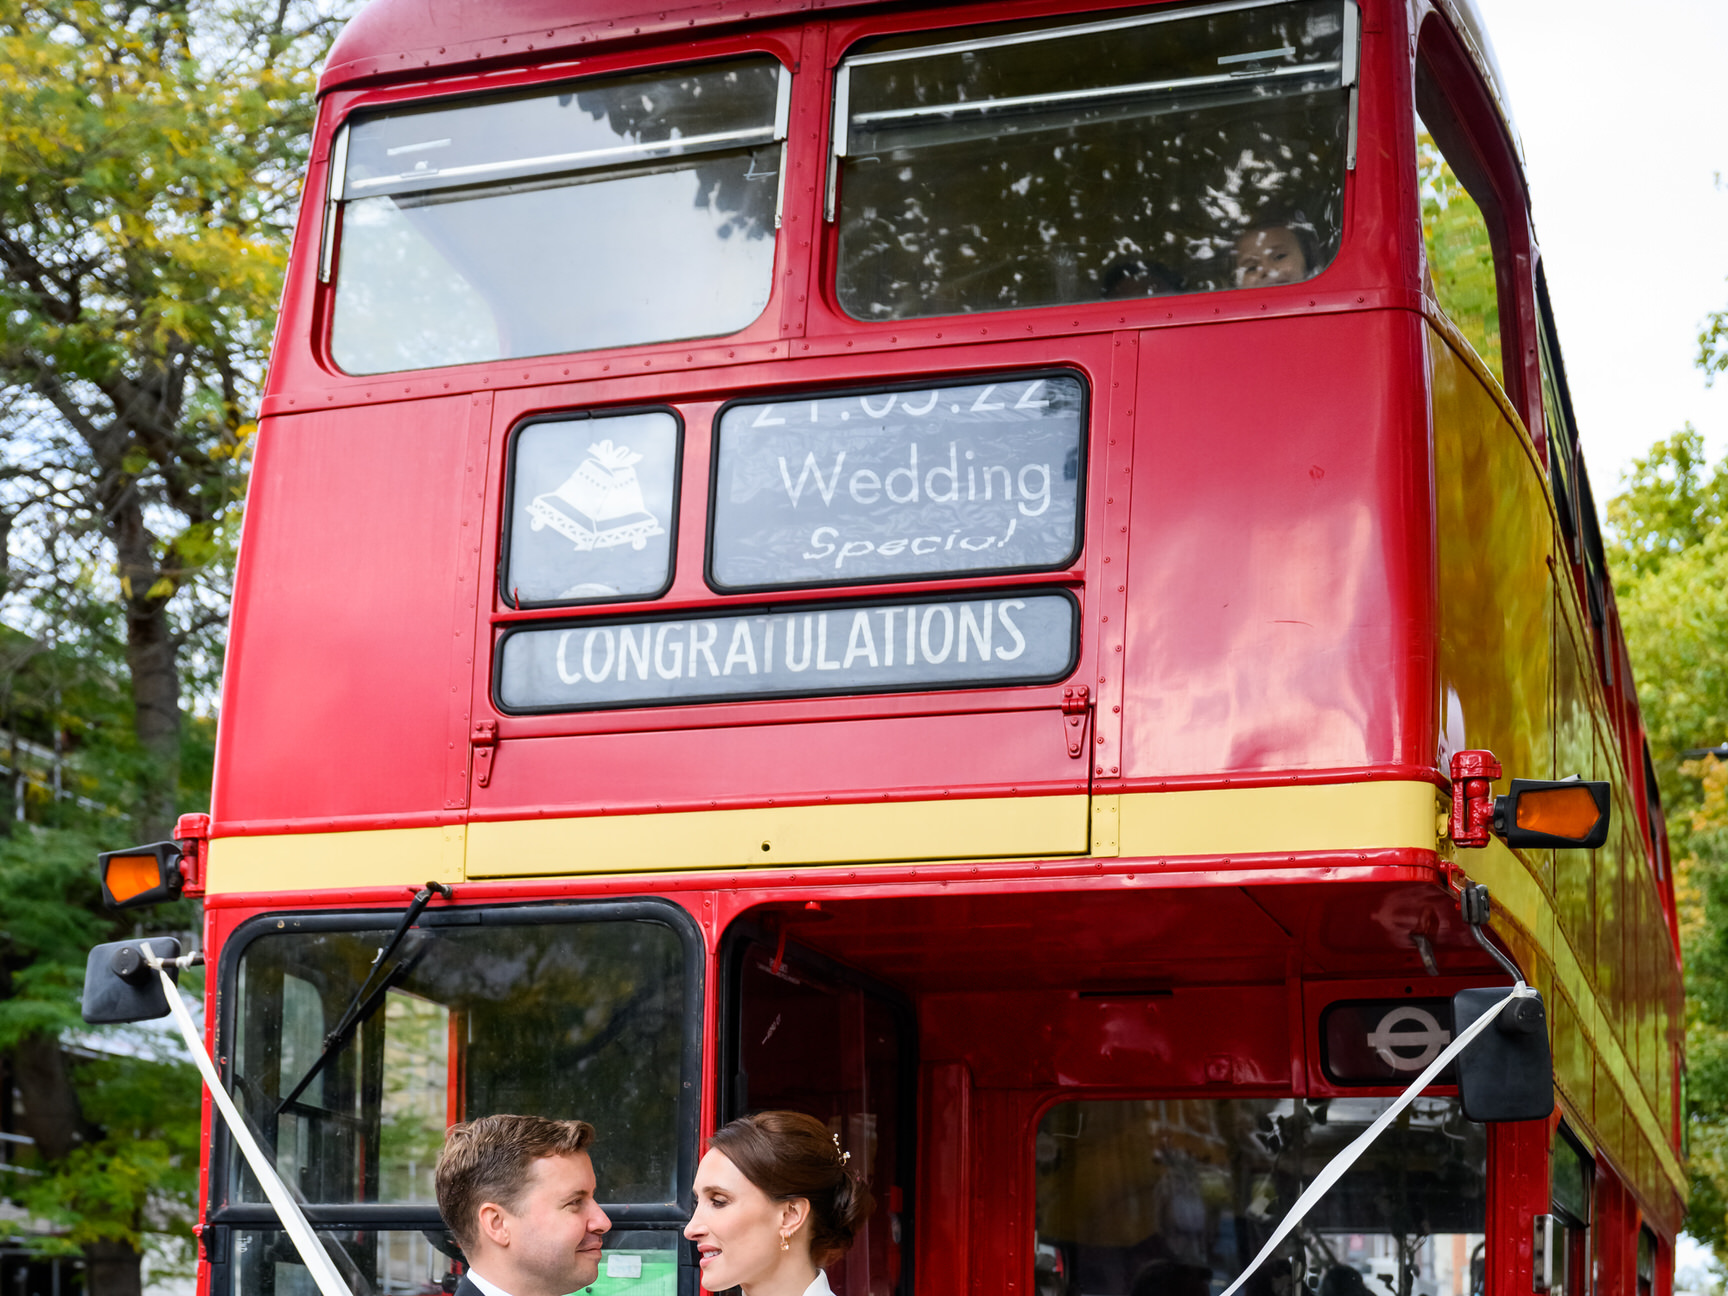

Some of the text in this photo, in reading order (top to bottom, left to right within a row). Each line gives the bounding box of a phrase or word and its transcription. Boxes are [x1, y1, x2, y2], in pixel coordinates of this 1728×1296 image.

[778, 441, 1050, 516] Wedding
[802, 518, 1017, 569] Special
[556, 600, 1026, 685] CONGRATULATIONS
